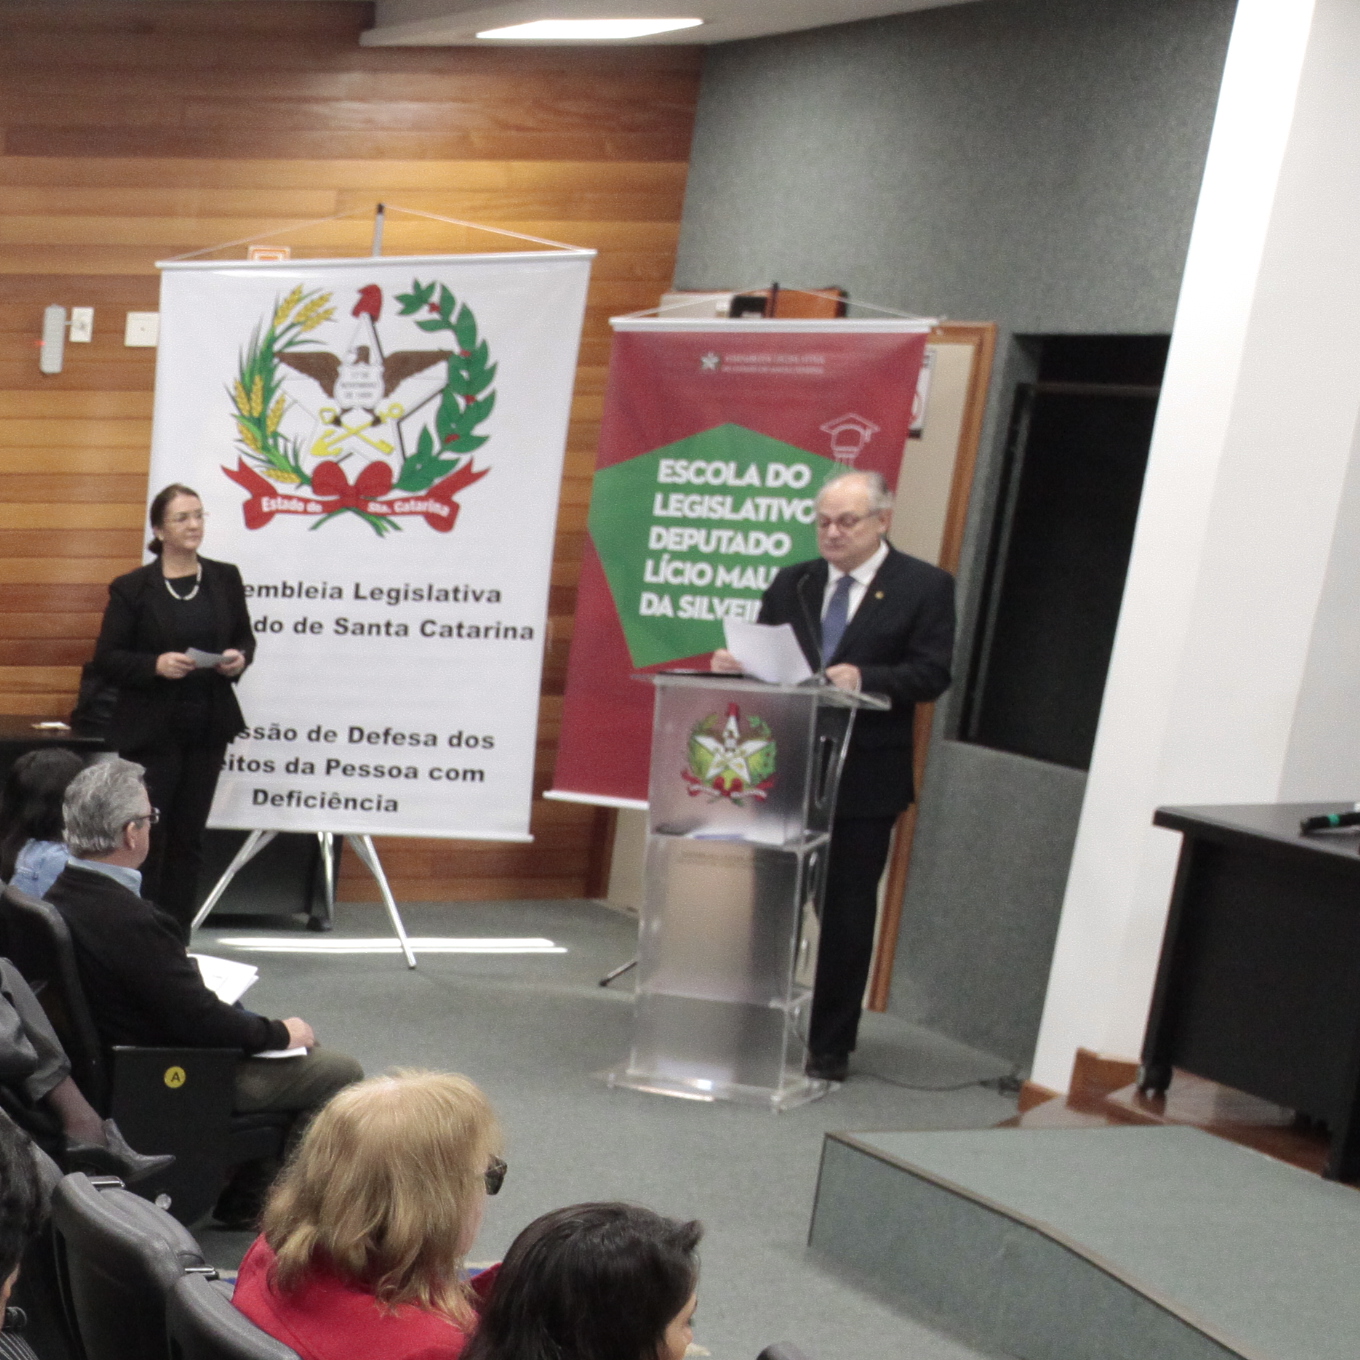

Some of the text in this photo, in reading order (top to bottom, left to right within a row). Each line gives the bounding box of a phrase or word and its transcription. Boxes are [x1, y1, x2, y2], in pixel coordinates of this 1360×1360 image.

[657, 458, 812, 489] ESCOLA DO
[651, 491, 817, 524] LEGISLATIVO
[648, 525, 792, 557] DEPUTADO
[643, 553, 780, 590] LÍCIO MAU
[243, 580, 502, 605] embleia Legislativa
[639, 591, 762, 623] DA SILVEI
[293, 616, 324, 635] de
[334, 617, 410, 638] Santa
[420, 619, 535, 640] Catarina
[237, 723, 495, 749] ssão de Defesa dos
[285, 757, 316, 775] da
[325, 758, 419, 779] Pessoa
[429, 767, 486, 782] com
[252, 788, 399, 812] Deficiência
[170, 1071, 181, 1083] A
